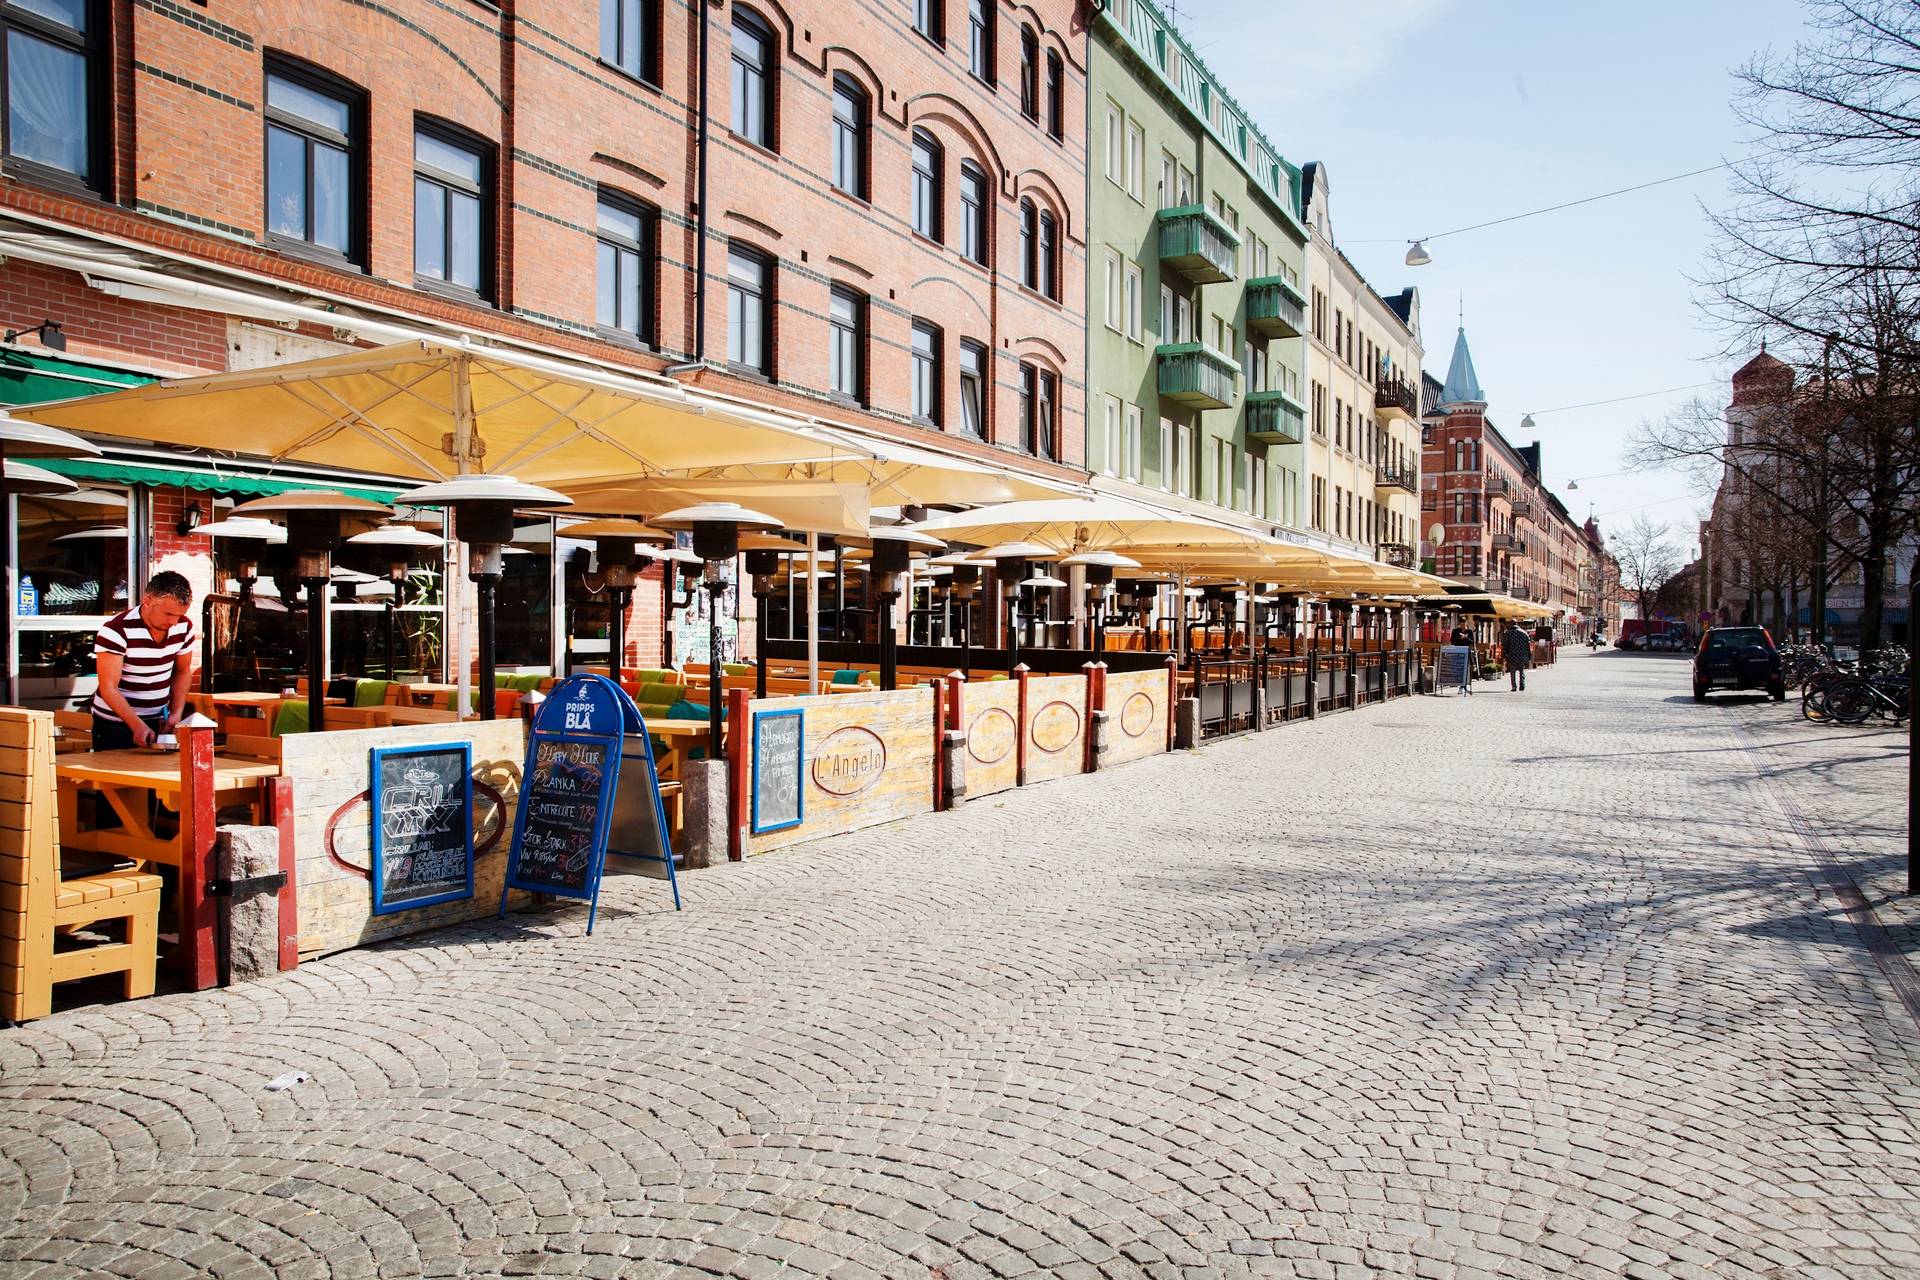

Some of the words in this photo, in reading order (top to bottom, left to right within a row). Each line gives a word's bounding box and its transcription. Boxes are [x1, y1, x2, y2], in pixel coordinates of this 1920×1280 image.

[566, 702, 595, 713] PRIPPS
[565, 712, 591, 729] BLÅ
[532, 769, 576, 791] PLANKA
